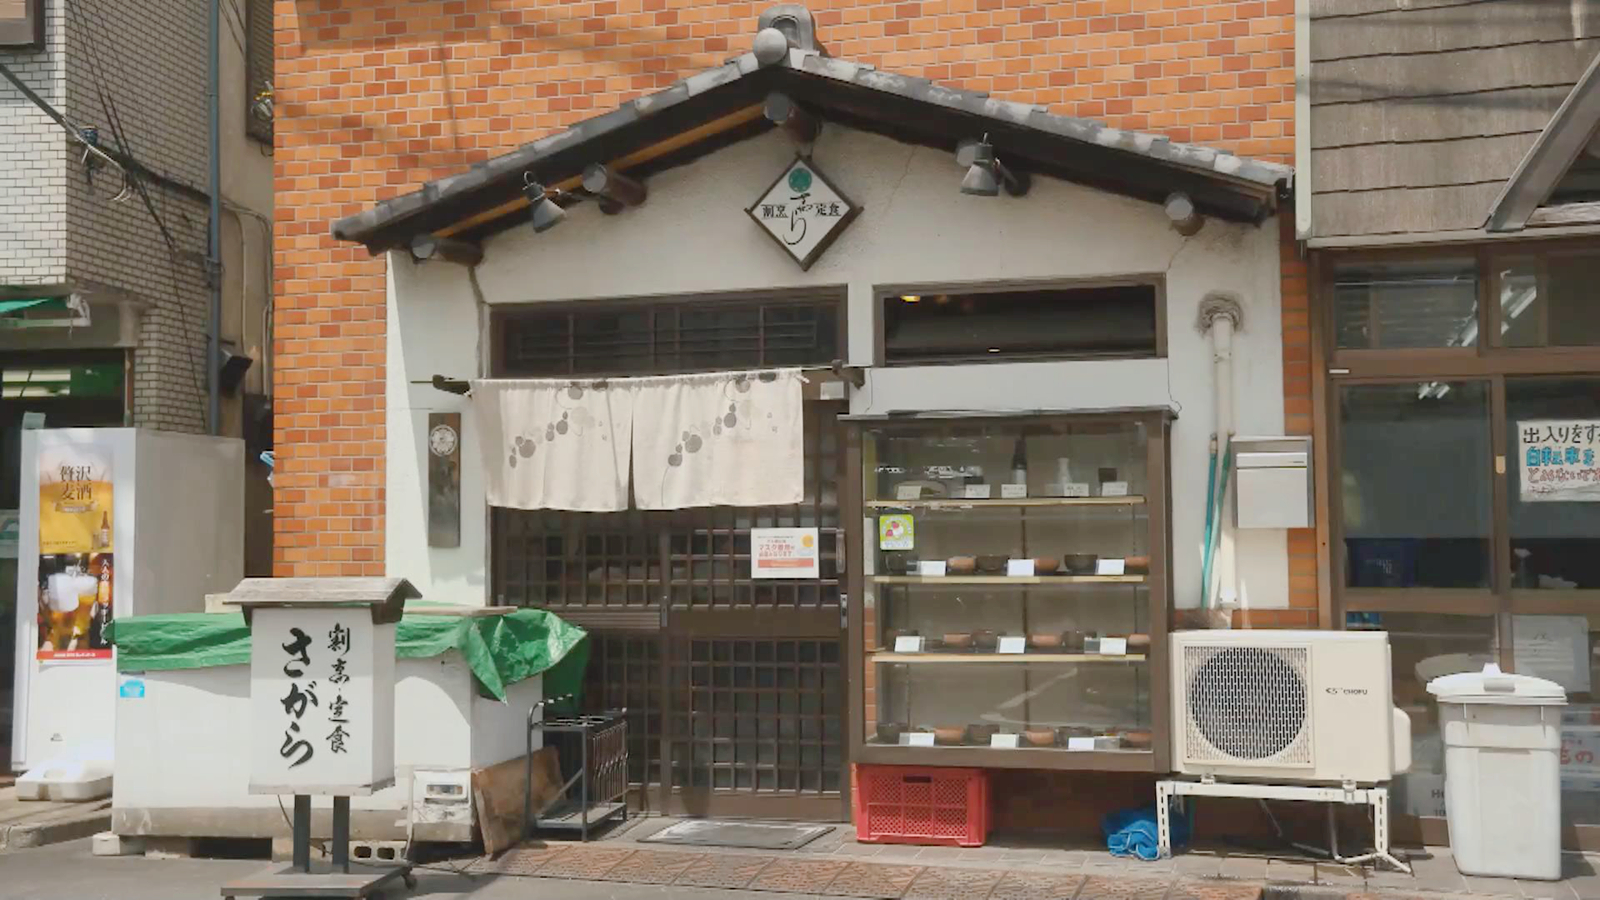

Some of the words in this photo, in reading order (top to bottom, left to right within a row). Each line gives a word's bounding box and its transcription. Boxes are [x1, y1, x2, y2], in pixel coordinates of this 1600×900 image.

[815, 203, 841, 217] 定食
[1523, 424, 1600, 444] 出入りをす
[279, 628, 319, 769] さがら
